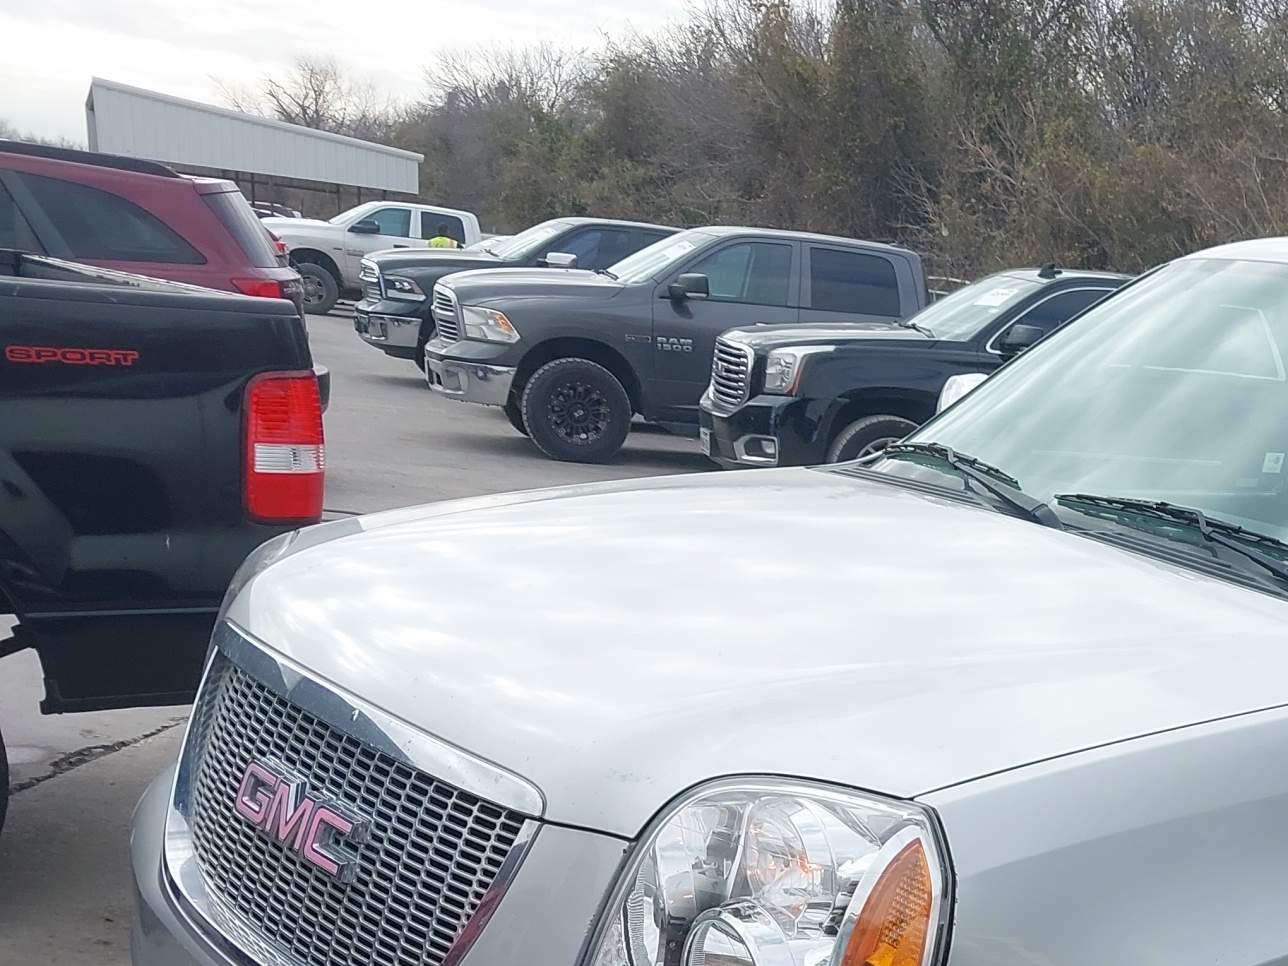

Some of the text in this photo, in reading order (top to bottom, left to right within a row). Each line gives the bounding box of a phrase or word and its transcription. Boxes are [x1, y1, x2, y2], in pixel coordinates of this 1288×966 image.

[656, 336, 693, 345] RAM
[657, 343, 693, 352] 1500
[5, 346, 139, 365] SPORT
[235, 760, 363, 880] GMC
